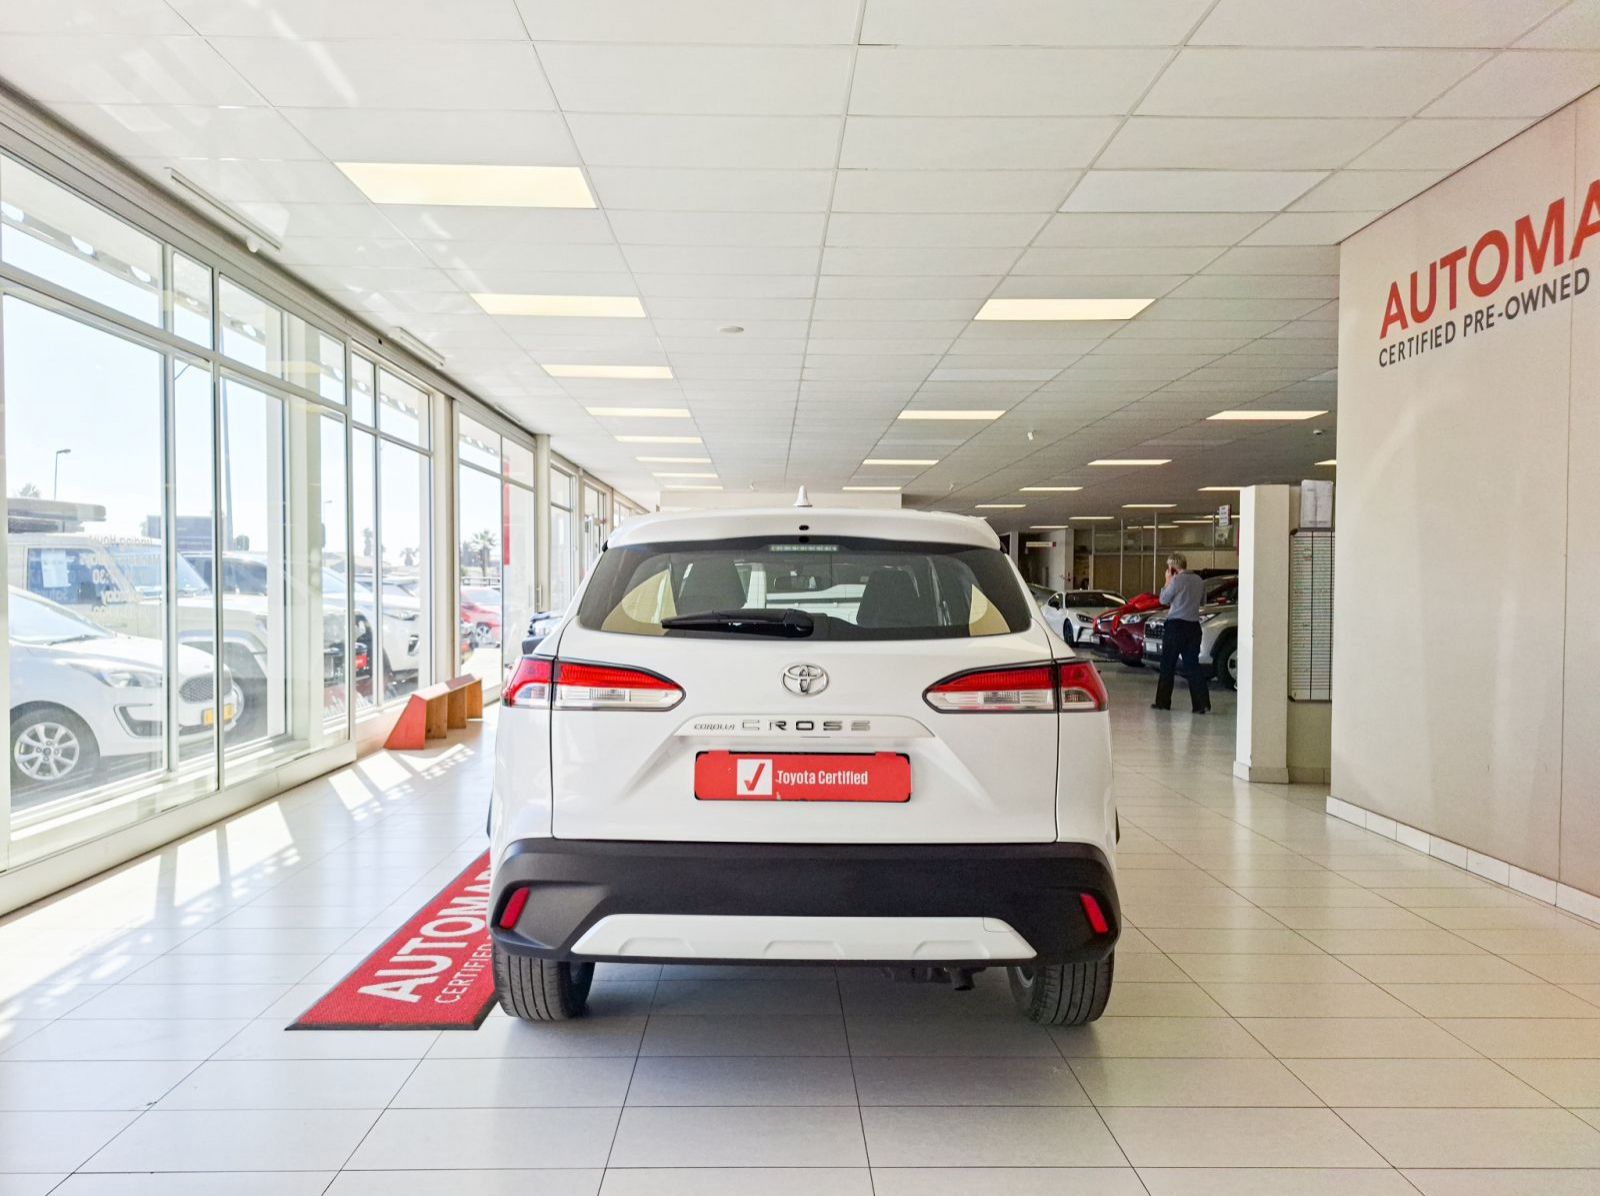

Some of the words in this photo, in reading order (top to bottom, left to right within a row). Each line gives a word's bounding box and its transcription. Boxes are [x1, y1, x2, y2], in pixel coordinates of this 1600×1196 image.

[1379, 320, 1456, 368] CERTIFIED
[1463, 267, 1590, 337] PRE-OWNED
[693, 723, 736, 731] COROLLA
[742, 719, 871, 732] CROSS
[776, 770, 816, 786] Toyota
[818, 770, 869, 785] Certified
